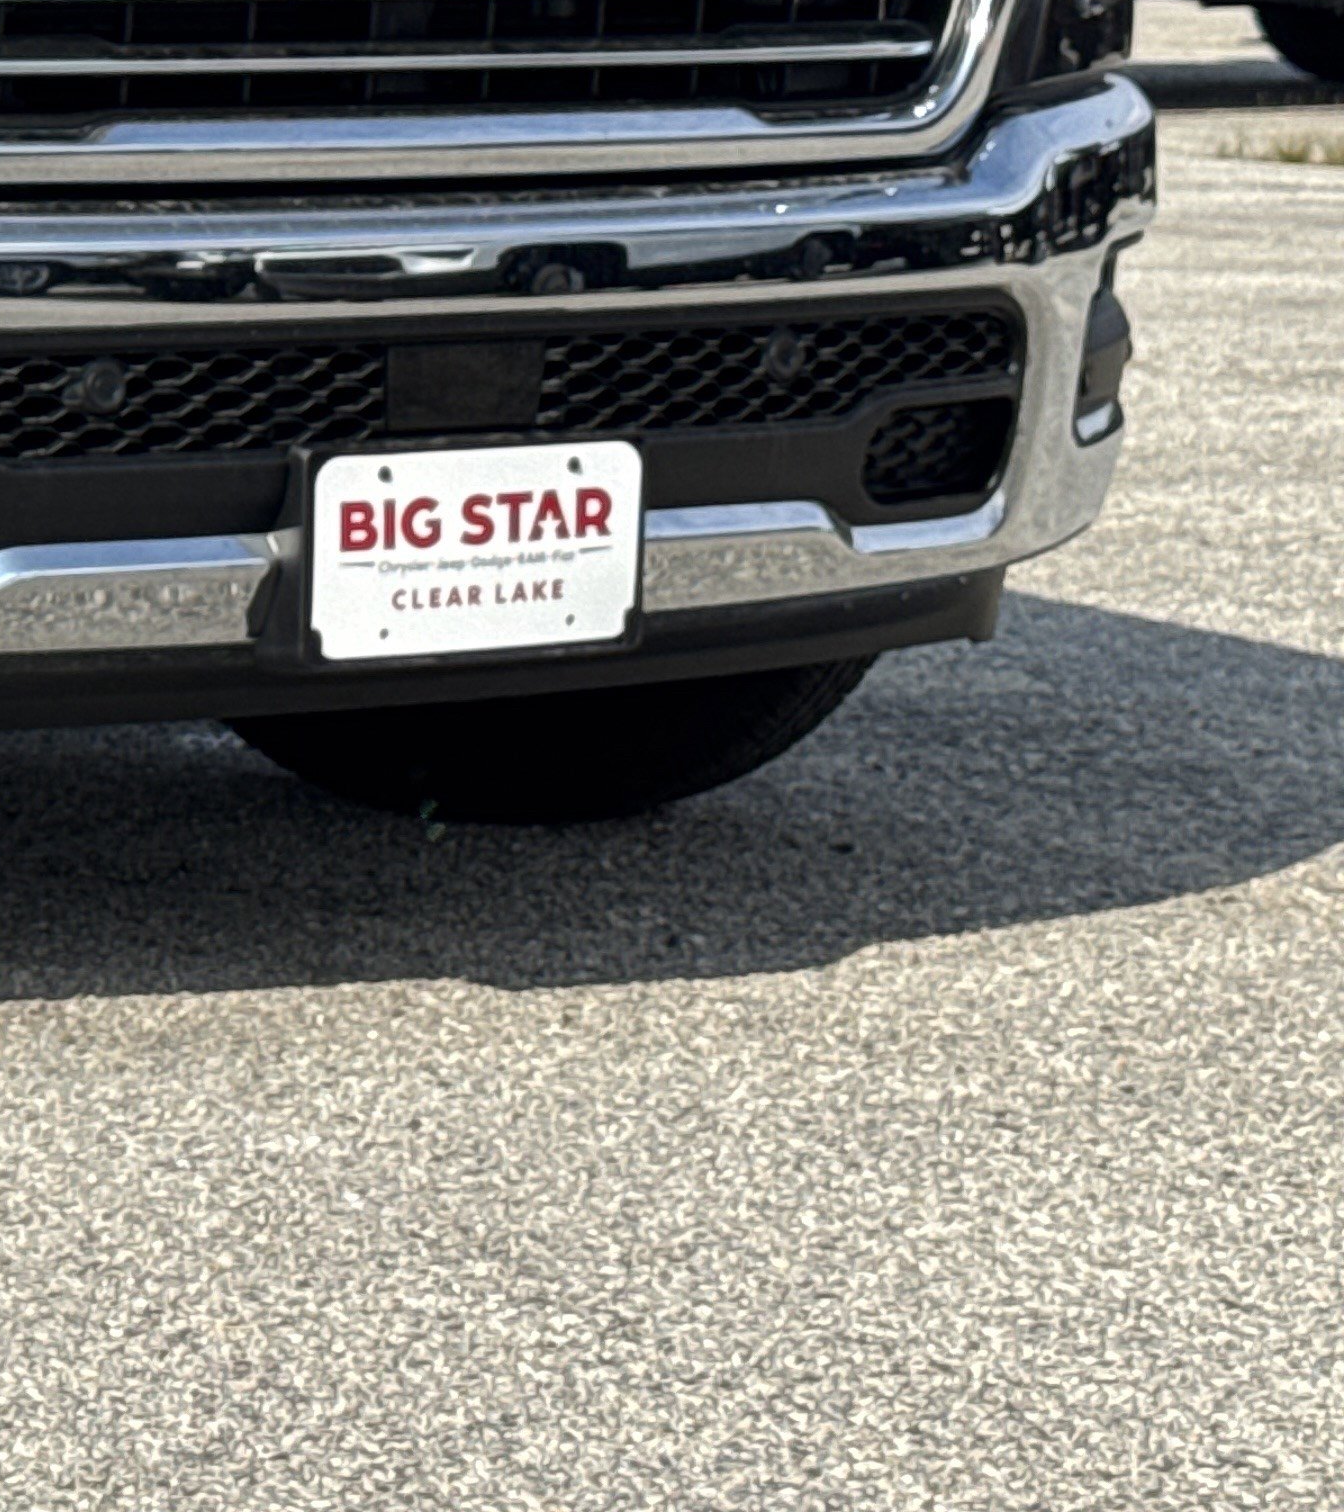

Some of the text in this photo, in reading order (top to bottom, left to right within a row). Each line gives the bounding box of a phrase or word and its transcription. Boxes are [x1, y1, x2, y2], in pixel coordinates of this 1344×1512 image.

[339, 486, 613, 552] BIG STAR
[391, 578, 565, 611] CLEAR LAKE
